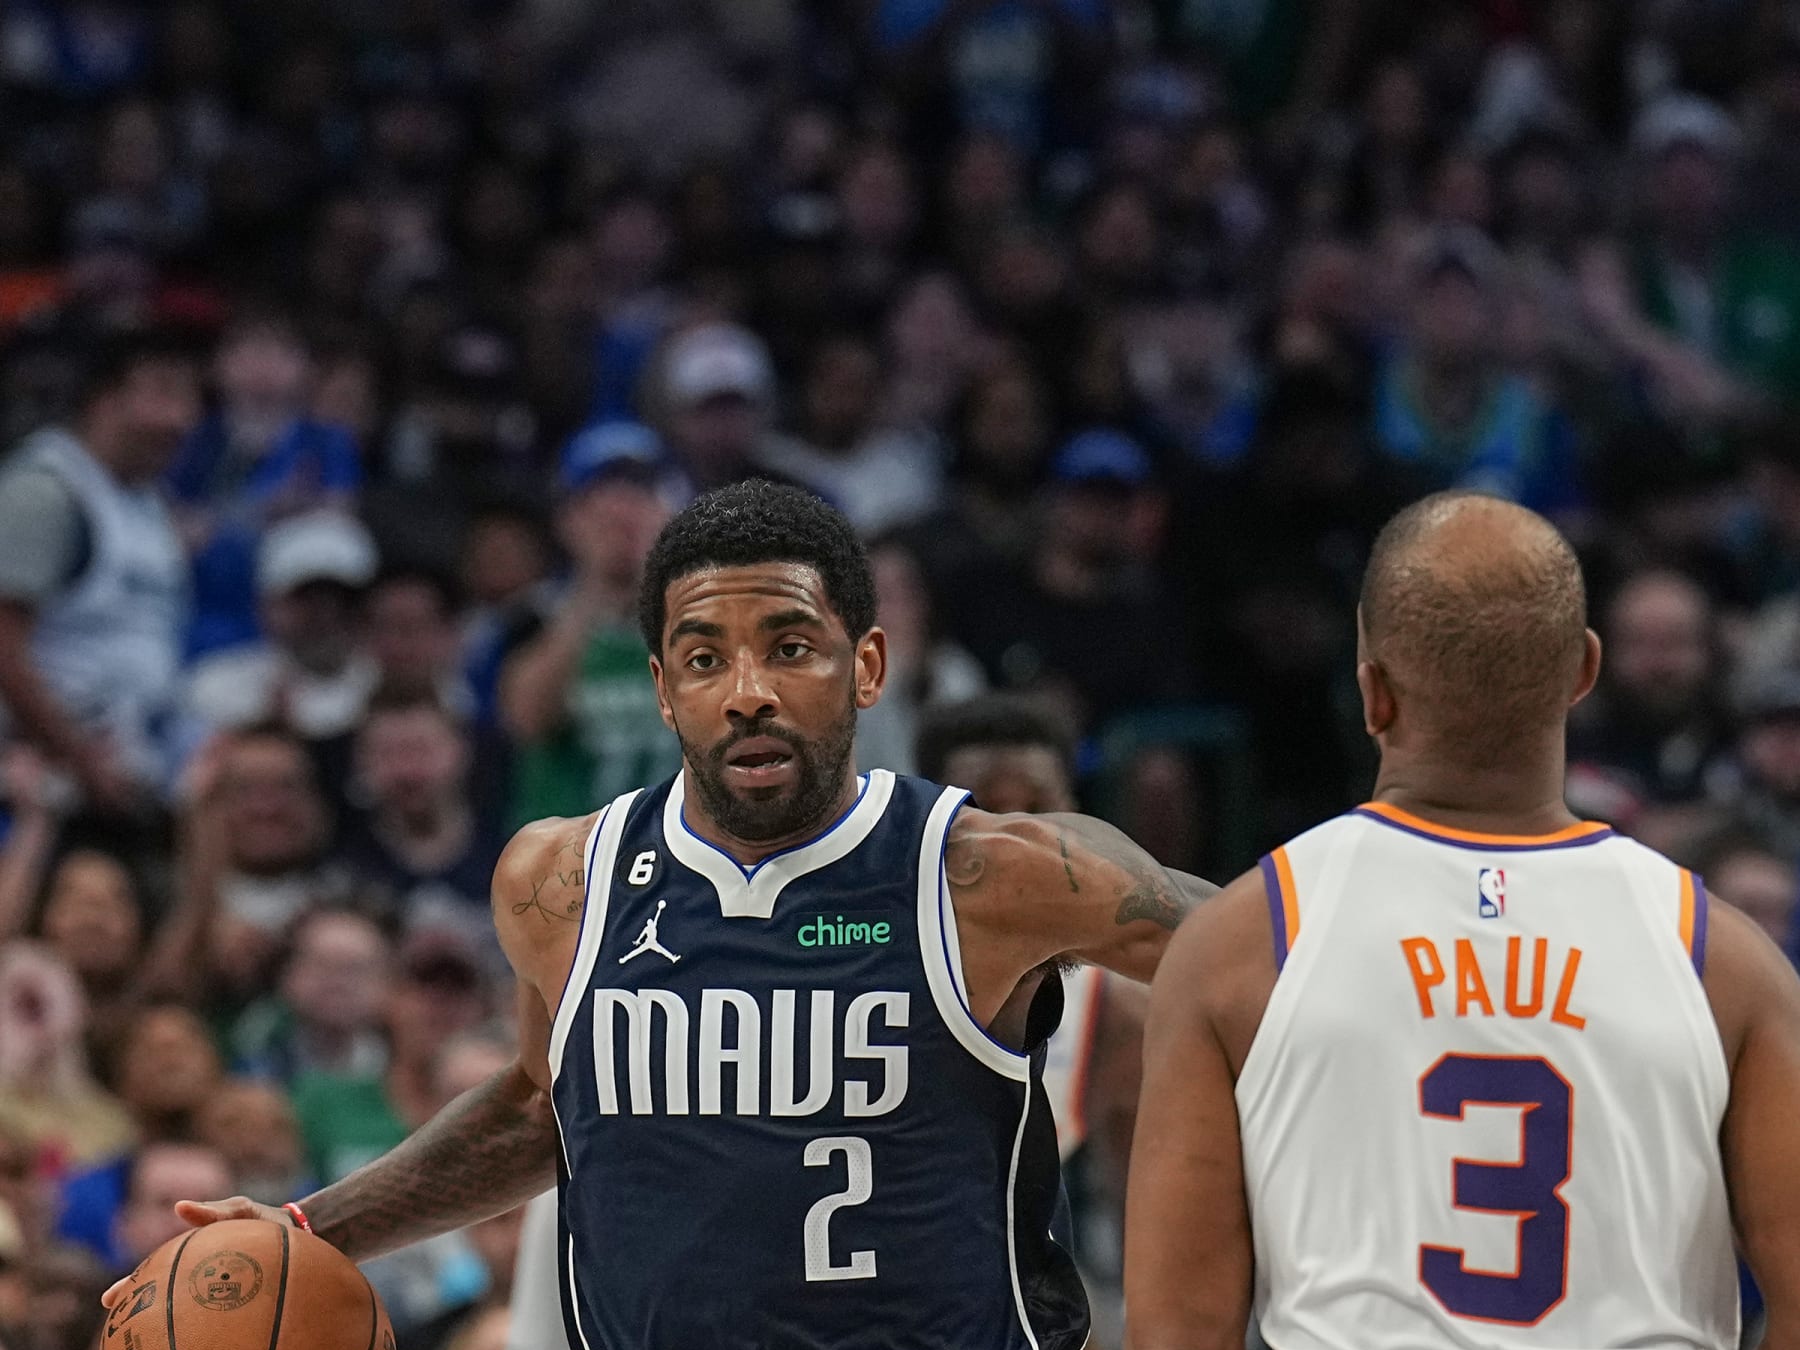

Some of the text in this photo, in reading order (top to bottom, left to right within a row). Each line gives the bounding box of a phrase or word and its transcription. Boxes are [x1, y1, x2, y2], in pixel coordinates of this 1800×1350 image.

[627, 850, 656, 885] 6
[798, 915, 890, 947] chime
[1400, 936, 1586, 1031] PAUL
[593, 988, 910, 1117] MAVS
[804, 1136, 877, 1282] 2
[1418, 1051, 1573, 1328] 3
